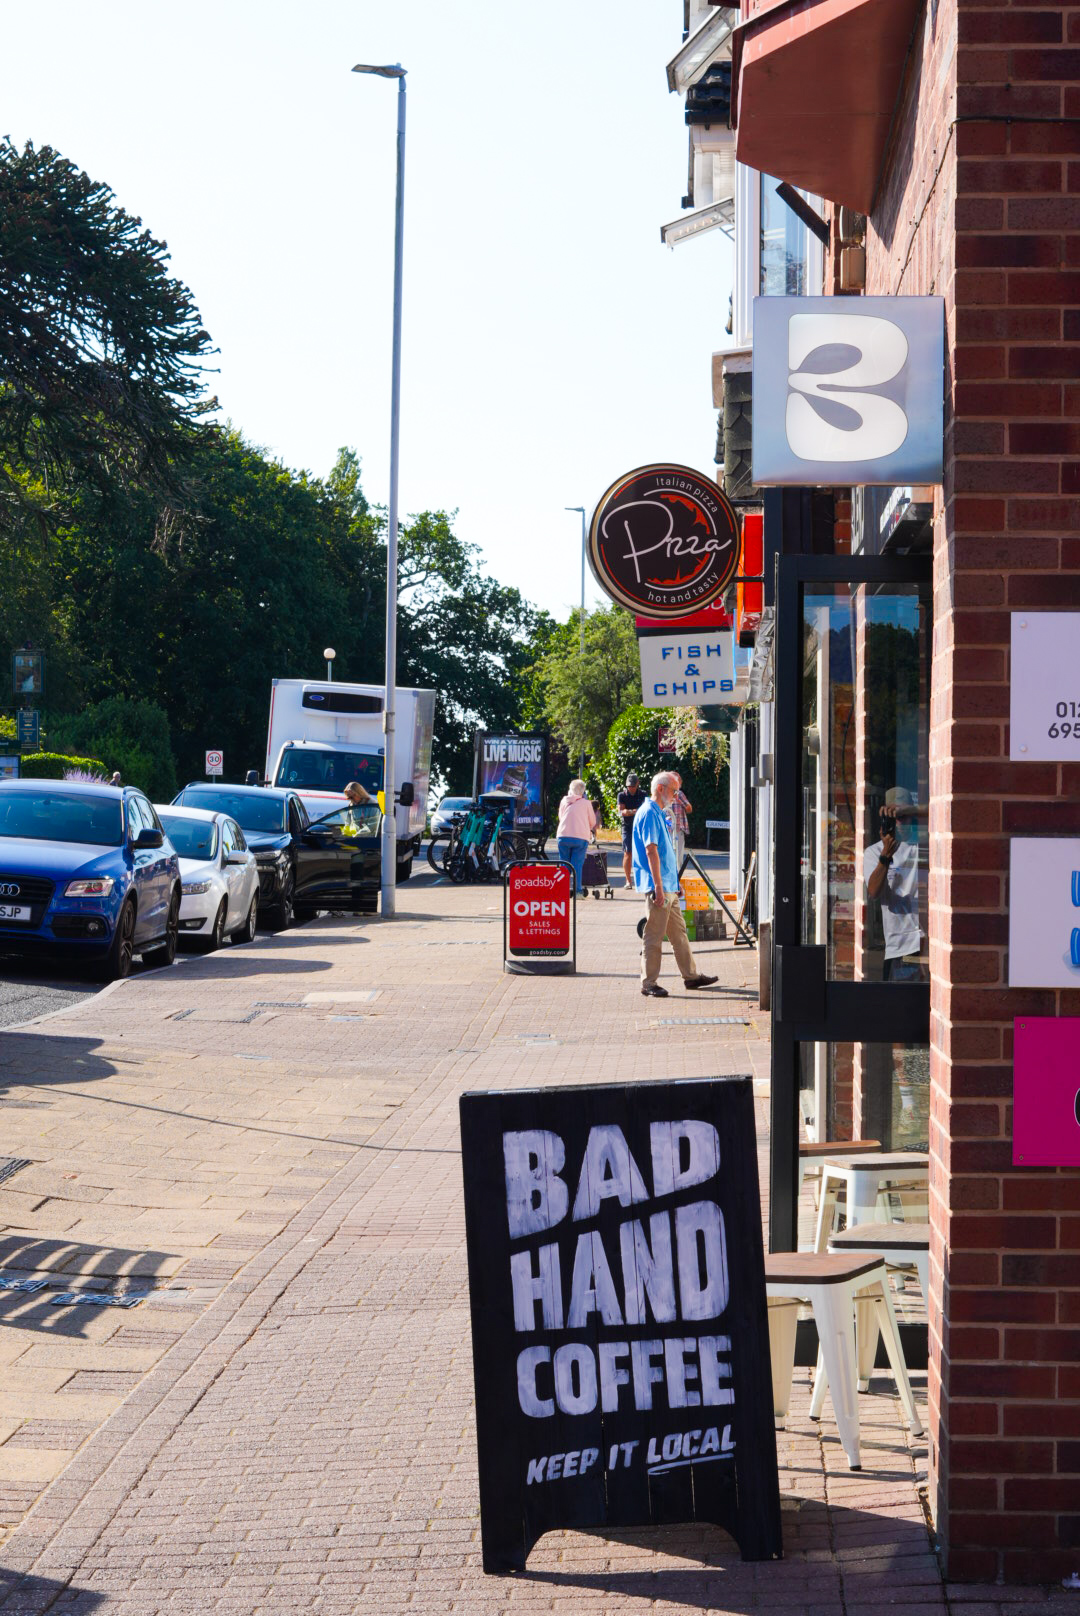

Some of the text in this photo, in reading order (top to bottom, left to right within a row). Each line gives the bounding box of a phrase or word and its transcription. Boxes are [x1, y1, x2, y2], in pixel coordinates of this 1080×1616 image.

[656, 477, 718, 513] Italian pizza
[647, 572, 719, 603] hot and tasty
[661, 644, 722, 661] FISH
[684, 663, 701, 677] &
[653, 679, 734, 697] CHIPS
[1056, 702, 1080, 718] 01
[209, 755, 220, 763] 30
[483, 744, 541, 762] LIVE MUSIC
[514, 876, 556, 890] goadsby
[513, 901, 566, 917] OPEN
[529, 920, 551, 928] SALES
[502, 1119, 721, 1240] BAD
[510, 1199, 731, 1332] HAND
[517, 1335, 736, 1419] COFFEE
[526, 1423, 737, 1486] KEEP IT LOCAL
